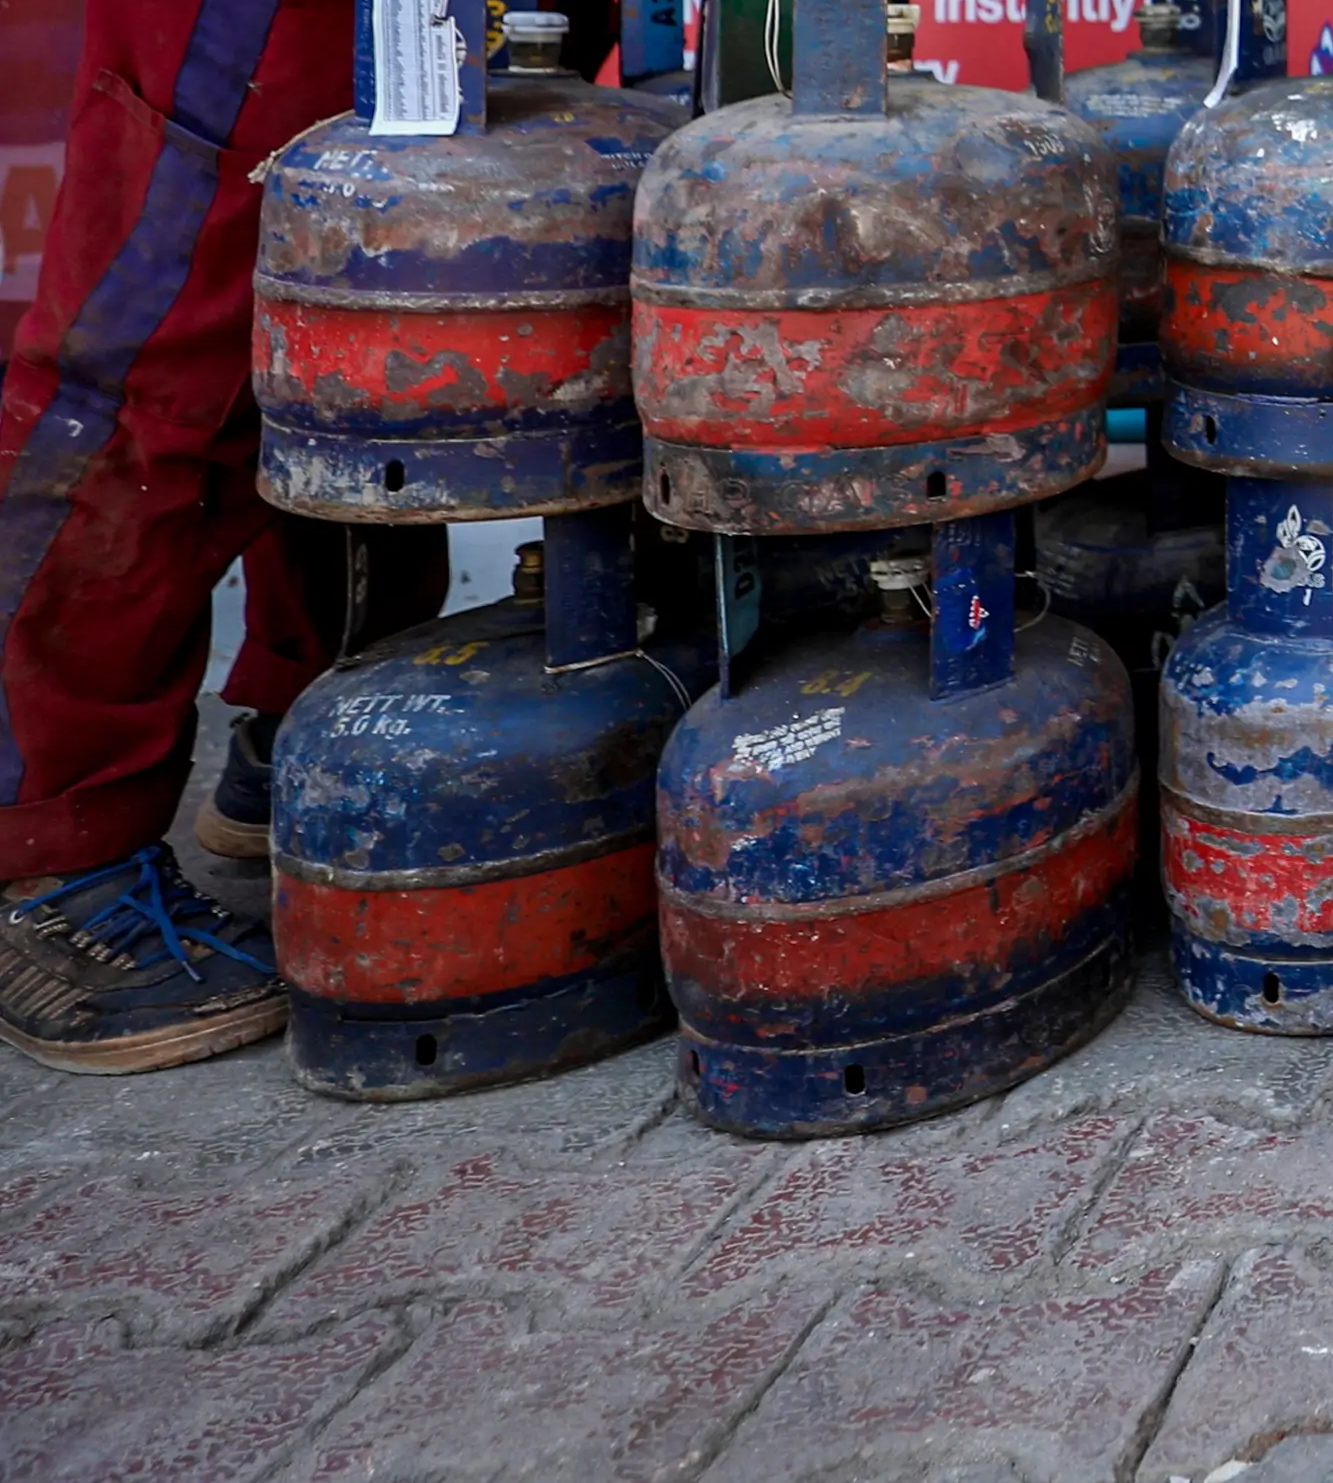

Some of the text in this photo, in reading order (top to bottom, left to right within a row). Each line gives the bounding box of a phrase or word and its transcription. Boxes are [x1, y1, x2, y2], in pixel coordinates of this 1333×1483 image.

[330, 694, 403, 717] NETT
[329, 714, 412, 741] 5.0 kg.
